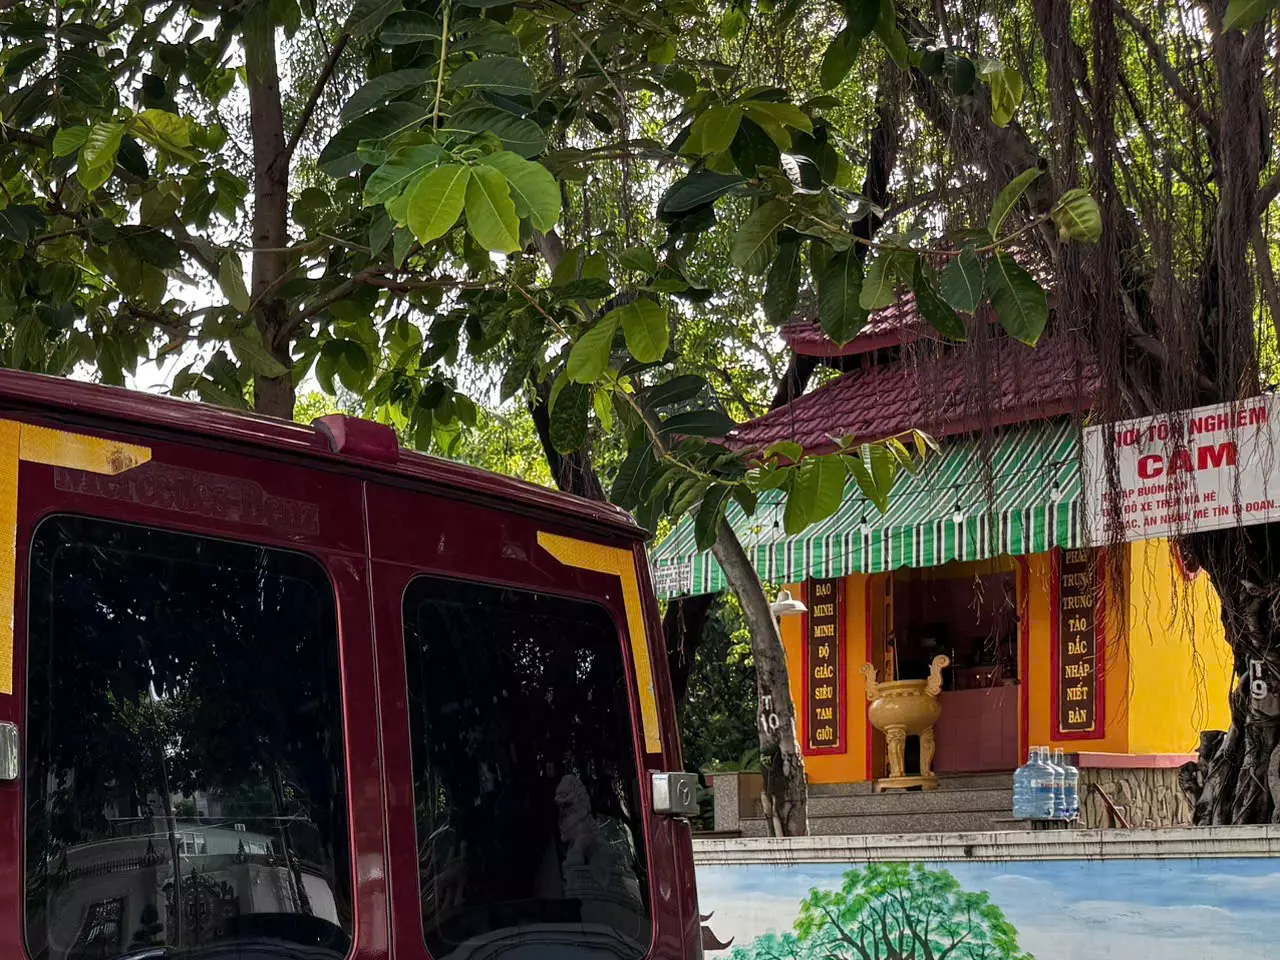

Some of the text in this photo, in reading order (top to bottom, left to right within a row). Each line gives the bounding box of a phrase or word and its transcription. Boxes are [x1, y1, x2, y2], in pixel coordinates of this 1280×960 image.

[1141, 501, 1152, 512] XE
[813, 604, 834, 617] MINH
[814, 624, 834, 637] MINH
[1252, 679, 1268, 699] 9
[761, 694, 772, 711] T
[816, 707, 833, 720] TAM
